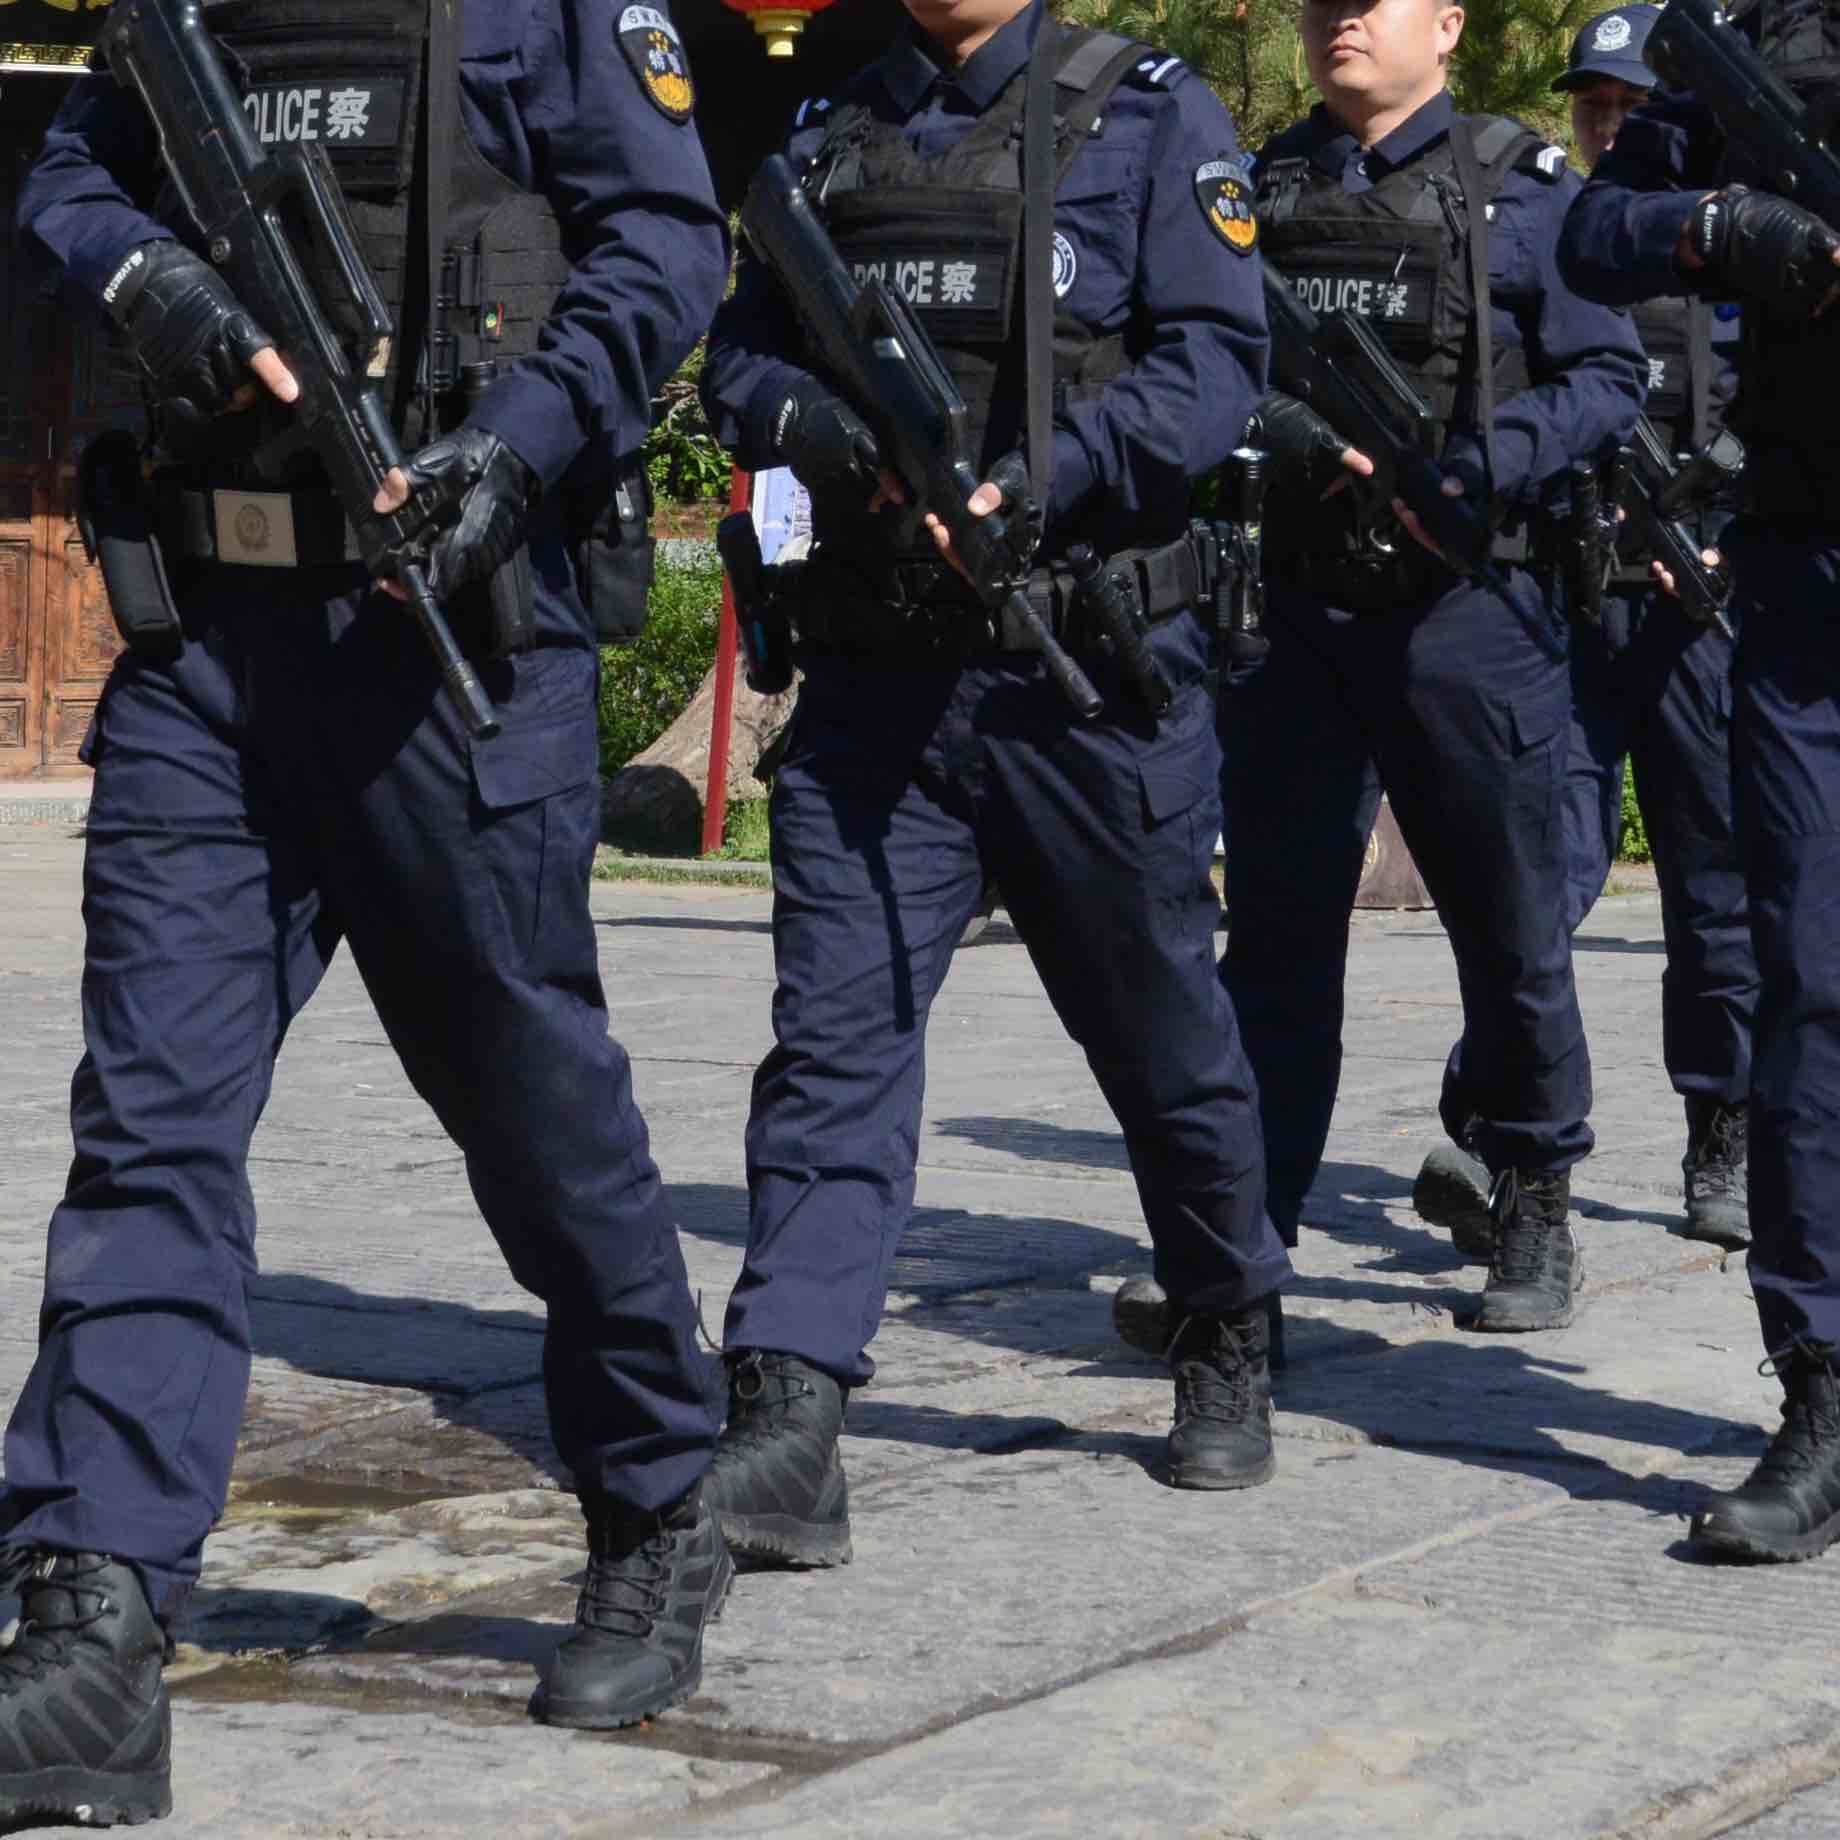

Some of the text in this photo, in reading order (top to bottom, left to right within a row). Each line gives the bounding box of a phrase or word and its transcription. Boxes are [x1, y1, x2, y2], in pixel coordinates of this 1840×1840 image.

[326, 87, 371, 140] 察
[940, 260, 977, 304] 察
[1296, 277, 1372, 316] POLICE
